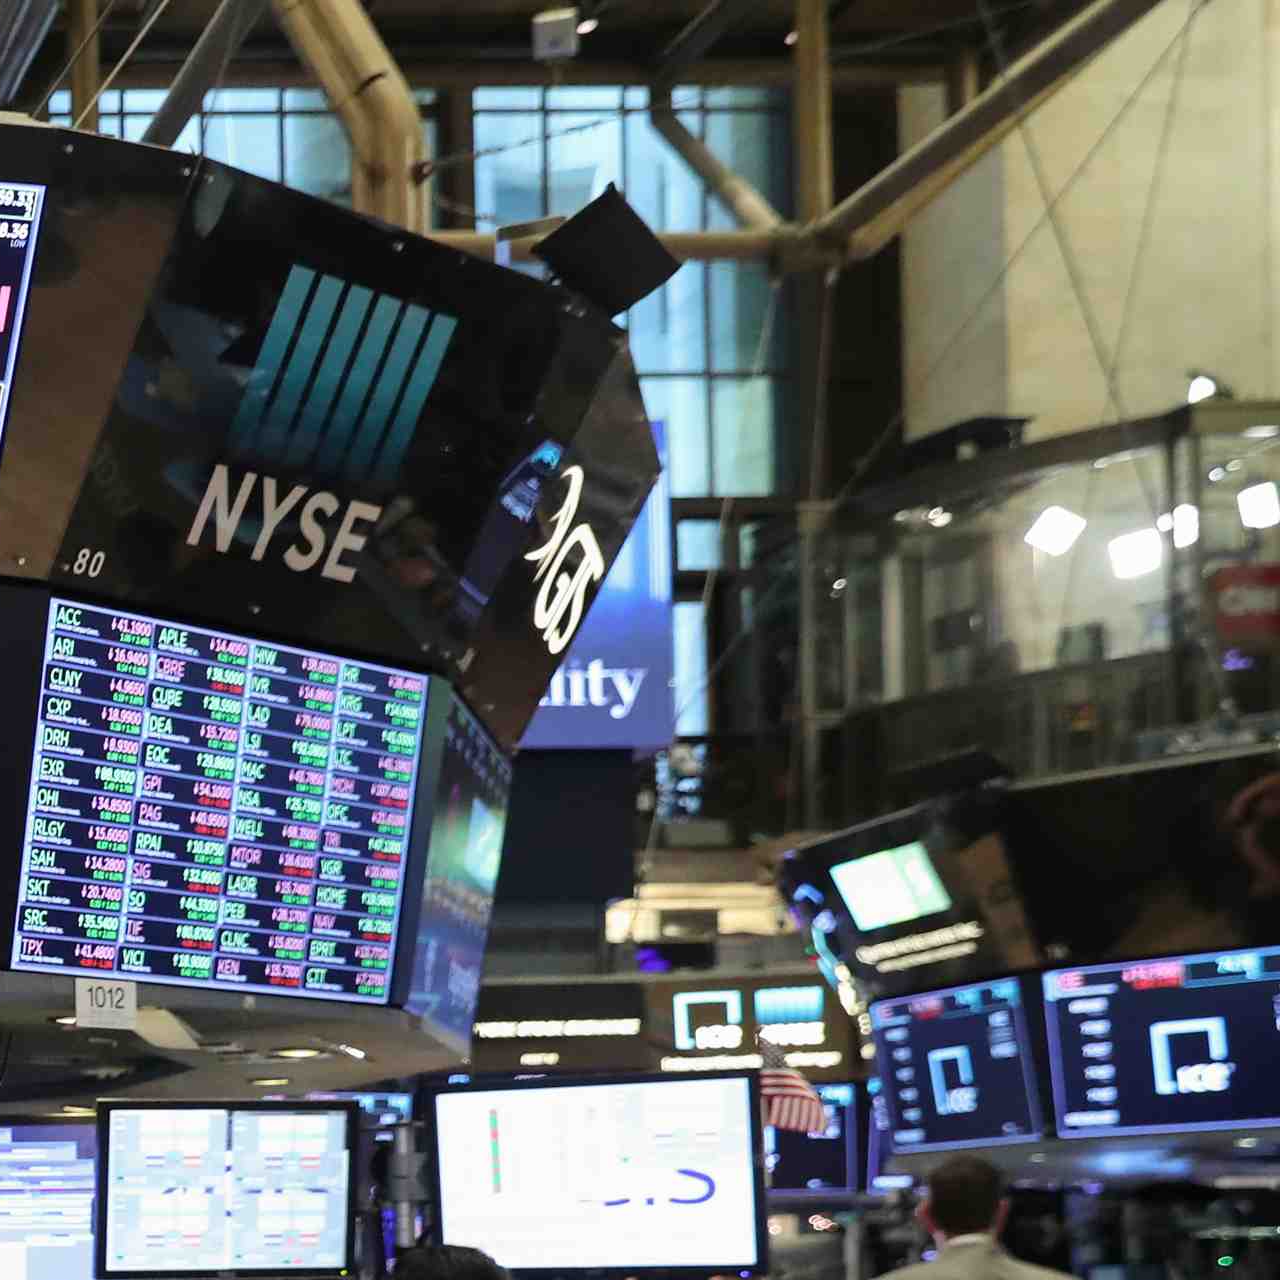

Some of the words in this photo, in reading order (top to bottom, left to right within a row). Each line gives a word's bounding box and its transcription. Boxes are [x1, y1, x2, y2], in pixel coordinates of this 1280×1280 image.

[186, 463, 382, 584] NYSE
[50, 667, 83, 690] CLNY
[87, 986, 125, 1009] 1012
